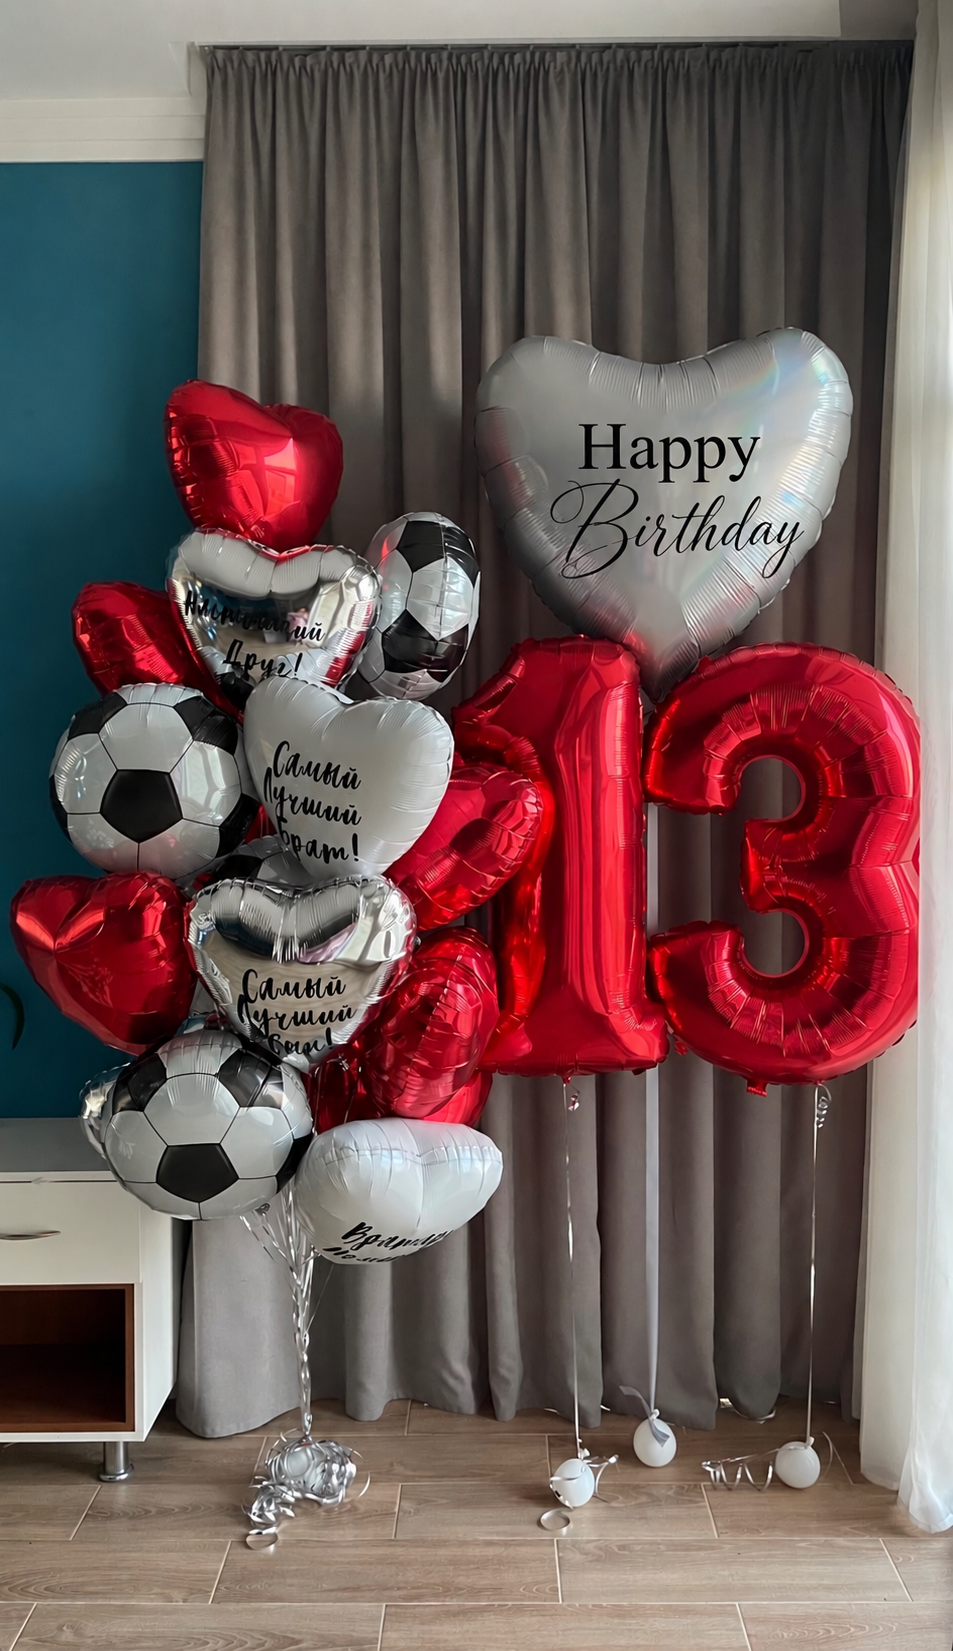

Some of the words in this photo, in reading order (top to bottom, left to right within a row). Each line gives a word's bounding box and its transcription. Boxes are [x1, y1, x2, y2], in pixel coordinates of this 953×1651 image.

[578, 423, 761, 483] Happy
[549, 478, 805, 579] Birthday
[222, 638, 304, 681] Друг!
[272, 740, 362, 790] Самый
[263, 766, 362, 826] Лучший
[276, 815, 360, 865] Брат!
[242, 968, 347, 1004] Самый
[237, 993, 358, 1039] Лучший
